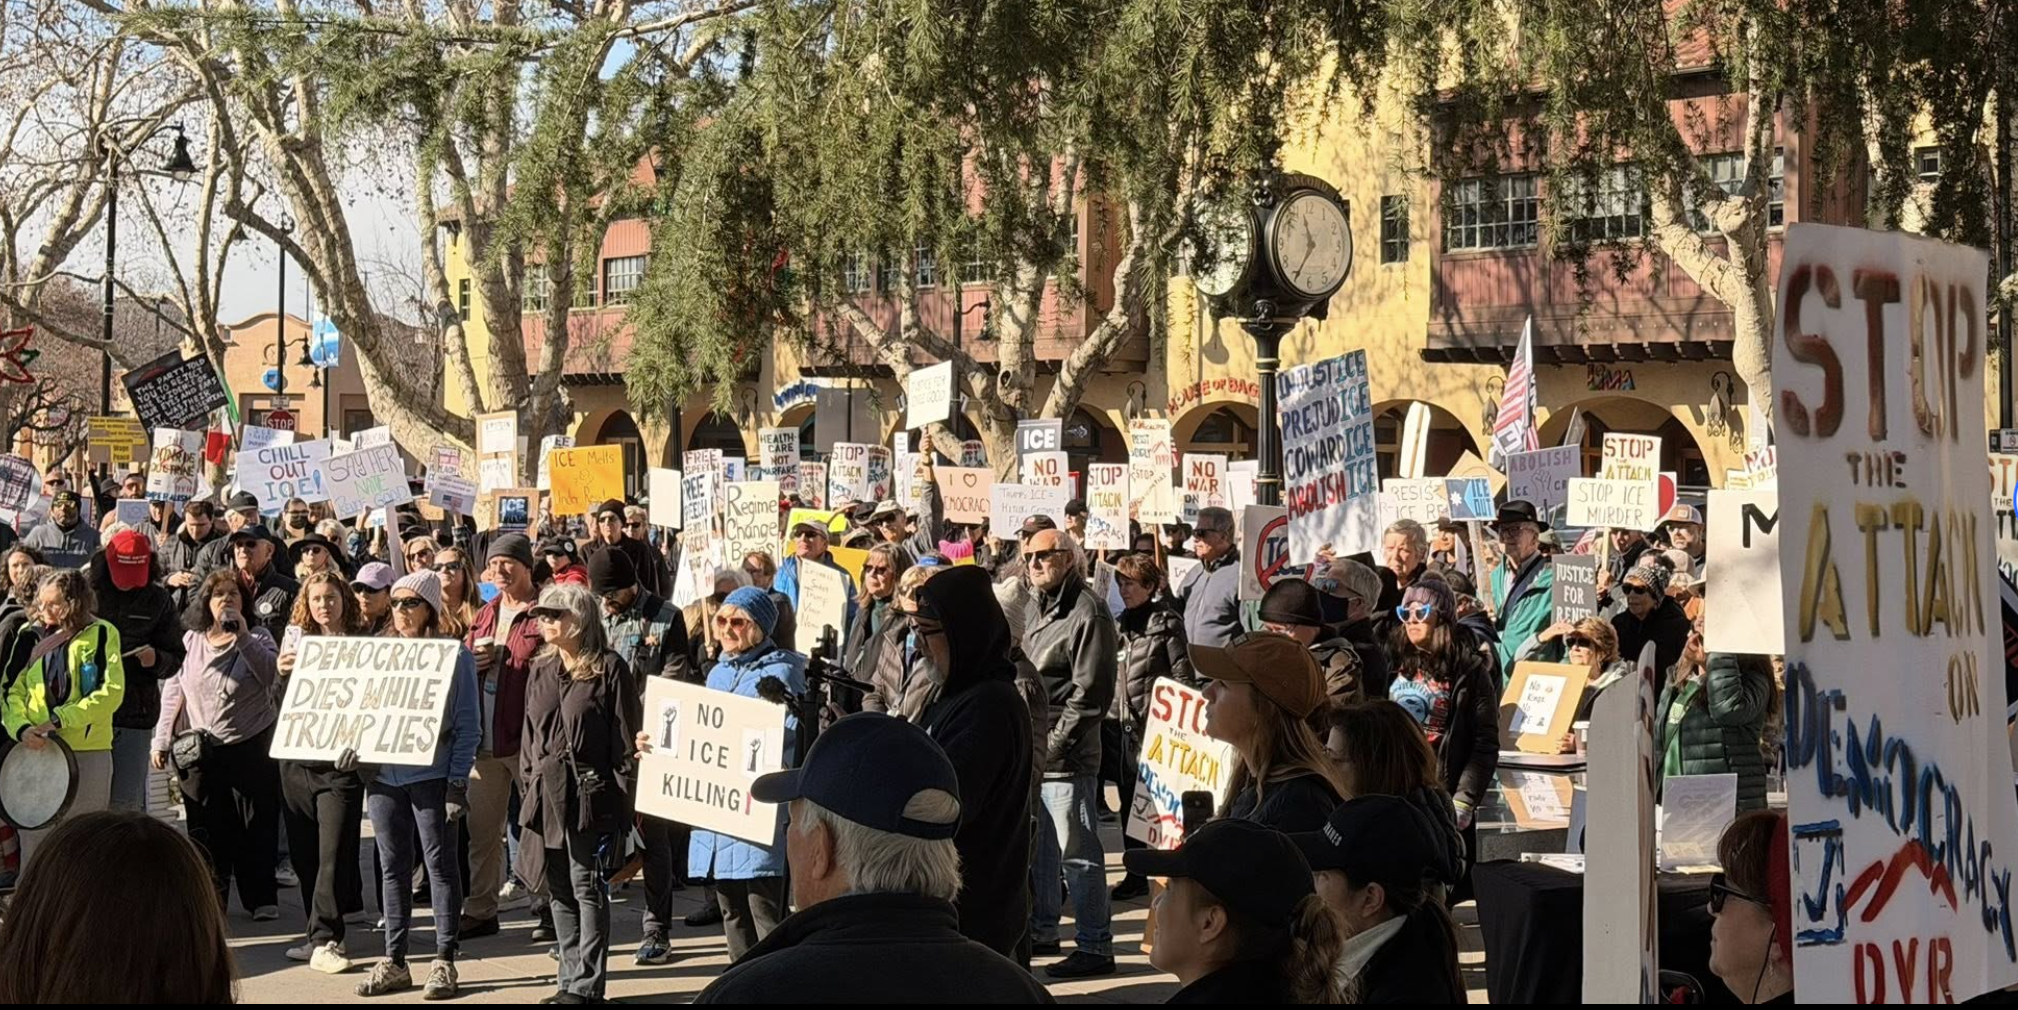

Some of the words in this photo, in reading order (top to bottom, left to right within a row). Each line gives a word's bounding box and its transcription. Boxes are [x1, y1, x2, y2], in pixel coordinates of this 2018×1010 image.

[1288, 176, 1328, 192] ONCORD
[1306, 200, 1314, 215] 12
[1331, 222, 1337, 234] 2
[1278, 238, 1284, 250] 9
[1336, 239, 1341, 252] 3
[1282, 254, 1289, 268] 8
[1332, 256, 1338, 270] 4
[1306, 276, 1312, 289] 6
[1321, 272, 1328, 284] 5
[1781, 262, 1977, 444] STOP
[136, 382, 154, 395] THE
[157, 367, 185, 385] PARTY
[187, 358, 206, 370] TOLD
[138, 390, 158, 403] YOU
[157, 384, 170, 394] TO
[170, 367, 202, 386] REJECT
[1277, 350, 1366, 400] INJUSTICE
[138, 401, 154, 411] THE
[156, 381, 196, 403] EVIDENCE
[181, 388, 196, 400] AND
[1168, 380, 1211, 416] HOUSE
[1213, 379, 1227, 390] OF
[1228, 376, 1260, 398] BAG
[1281, 381, 1371, 441] PREJUDICE
[268, 418, 294, 428] STOP
[768, 443, 794, 452] CARE
[1024, 429, 1056, 450] ICE
[1604, 438, 1654, 459] STOP
[258, 444, 310, 464] CHILL
[554, 450, 576, 468] ICE
[587, 450, 614, 464] Melts
[684, 449, 718, 466] FREE
[770, 454, 789, 465] NOT
[832, 446, 864, 460] STOP
[1285, 422, 1374, 480] COWARDICE
[1510, 450, 1572, 472] ABOLISH
[1744, 448, 1774, 474] NO
[270, 461, 307, 480] OUT
[329, 453, 366, 482] SAY
[366, 446, 400, 474] HER
[760, 464, 798, 476] WARFARE
[1034, 458, 1058, 476] NO
[1192, 461, 1215, 478] NO
[1605, 464, 1652, 481] ATTACK
[1846, 451, 1907, 488] THE
[265, 469, 322, 502] ICE!
[950, 474, 953, 486] I
[1088, 466, 1122, 486] STOP
[1187, 478, 1218, 492] WAR
[374, 485, 408, 506] GOOD
[682, 474, 705, 501] REE
[1030, 488, 1048, 500] ICE
[1288, 470, 1347, 521] ABOLISH
[1347, 460, 1376, 500] ICE
[1390, 484, 1441, 502] RESIS
[1472, 479, 1490, 497] ICE
[1510, 486, 1528, 498] ICE
[1578, 482, 1613, 503] STOP
[1624, 486, 1646, 506] ICE
[727, 485, 778, 525] Regime
[944, 495, 991, 512] EMOCRACY
[1090, 492, 1122, 508] ATTACK
[1474, 498, 1493, 518] OUT
[1994, 498, 2012, 506] THE
[1586, 506, 1643, 528] MURDER
[1742, 502, 1779, 548] M
[726, 517, 778, 546] Change
[1556, 563, 1594, 585] JUSTICE
[1798, 500, 1986, 642] ATTACK
[1564, 585, 1585, 604] FOR
[1556, 605, 1592, 624] RENEE
[300, 640, 456, 672] DEMOCRACY
[291, 677, 358, 710] DIES
[360, 676, 442, 710] WHILE
[1530, 680, 1540, 692] No
[1946, 651, 1981, 724] ON
[1522, 703, 1531, 712] No
[1528, 694, 1545, 703] Kings
[697, 702, 724, 730] NO
[282, 712, 376, 751] TRUMP
[374, 714, 438, 754] LIES
[1169, 727, 1187, 742] THE
[690, 739, 729, 770] ICE
[1148, 734, 1219, 790] ATTACK
[1138, 762, 1182, 822] DEMOC
[1784, 661, 2017, 963] DEMOCRACY
